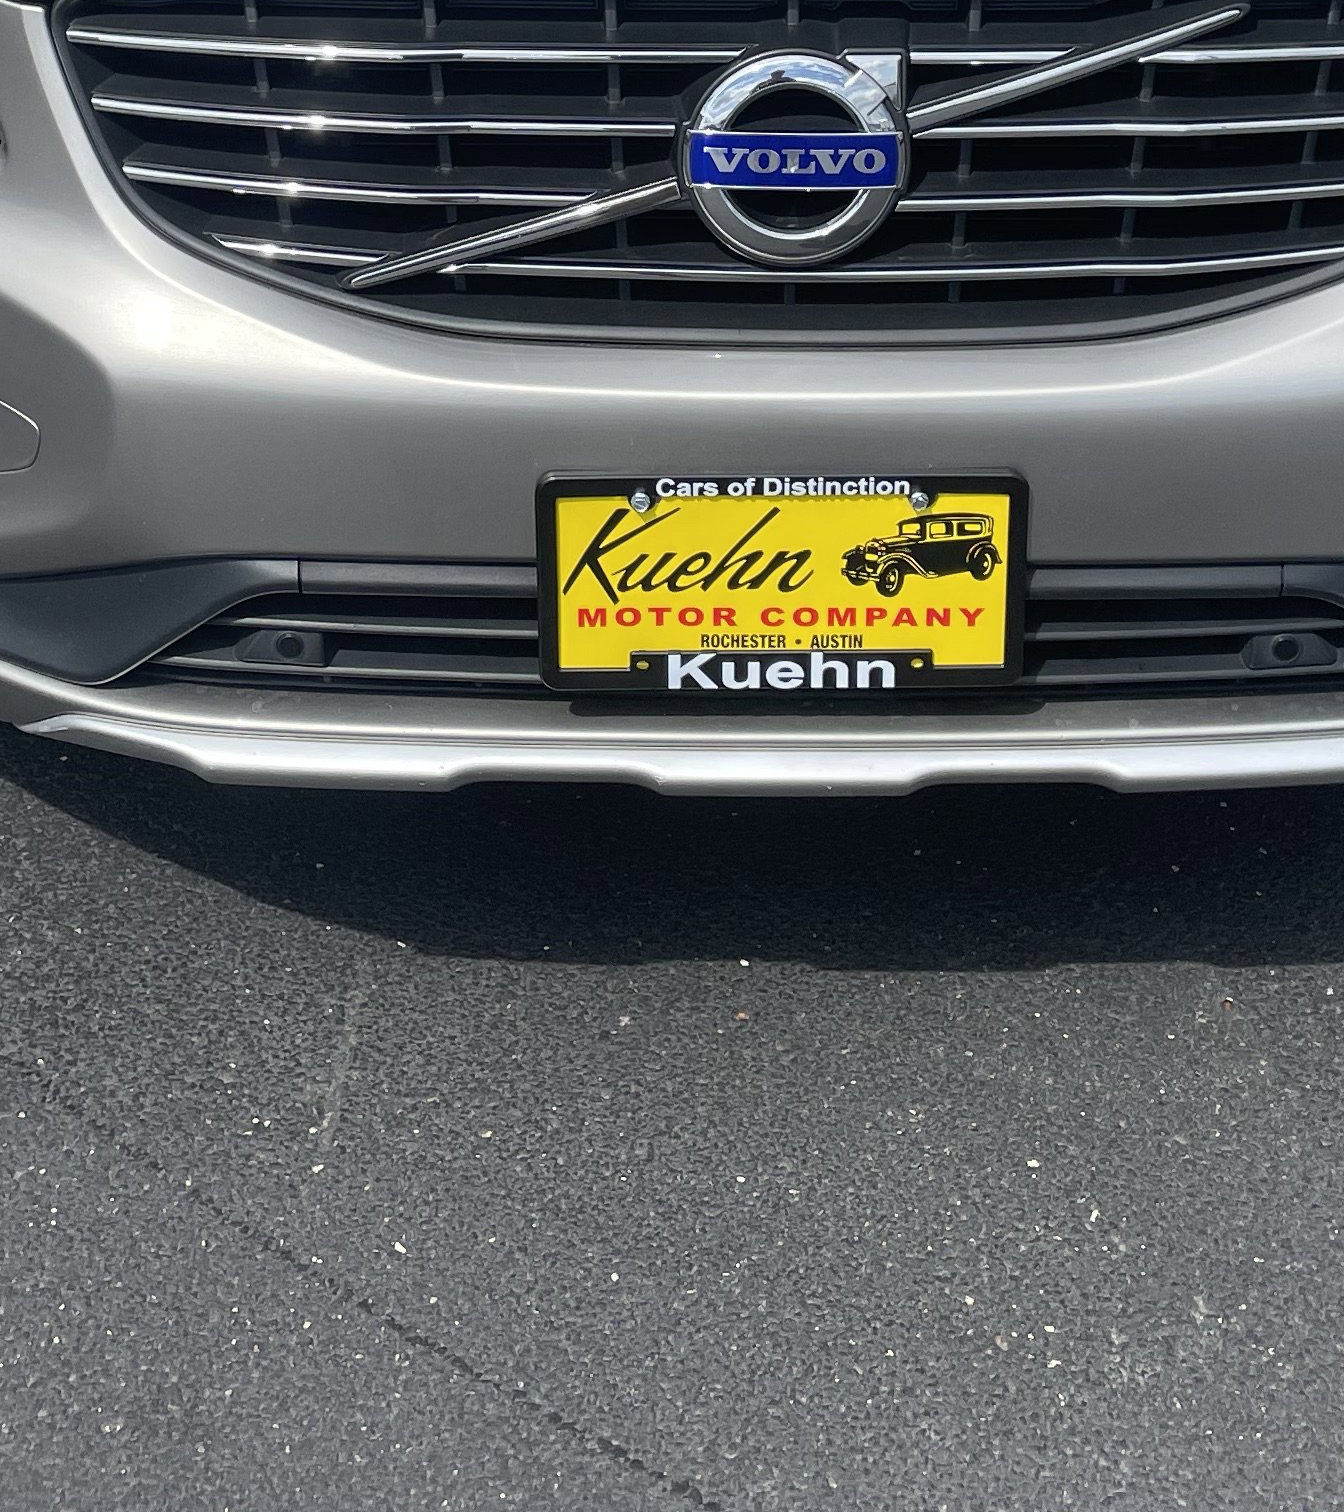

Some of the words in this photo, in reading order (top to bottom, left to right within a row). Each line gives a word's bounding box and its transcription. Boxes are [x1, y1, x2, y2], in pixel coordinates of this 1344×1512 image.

[703, 146, 886, 174] VOLVO
[655, 477, 719, 498] Cars
[727, 477, 755, 498] of
[763, 476, 911, 497] Distinction
[562, 506, 814, 605] Kuehn
[577, 606, 737, 628] MOTOR
[760, 606, 986, 628] COMPANY
[701, 633, 786, 649] ROCHESTER
[810, 634, 863, 649] AUSTIN
[667, 651, 896, 690] Kuehn
